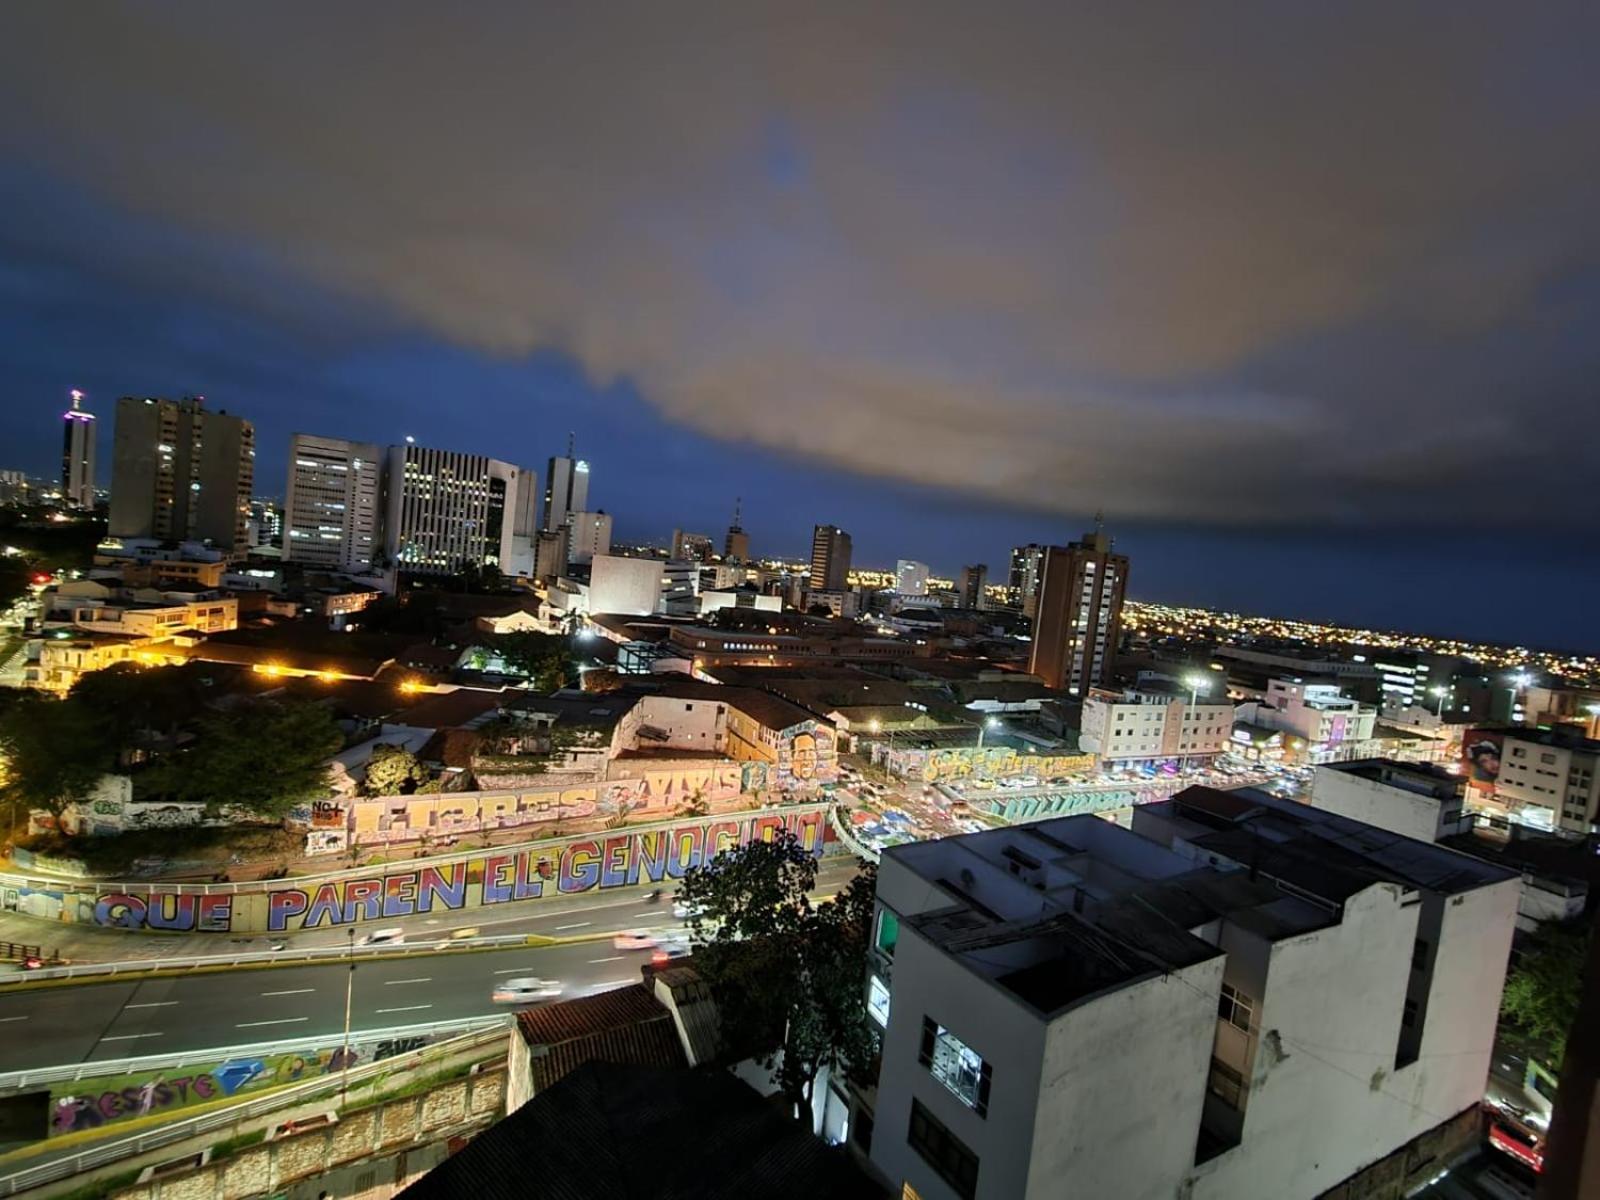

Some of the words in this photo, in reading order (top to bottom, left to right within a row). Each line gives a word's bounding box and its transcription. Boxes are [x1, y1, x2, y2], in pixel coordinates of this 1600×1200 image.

[95, 892, 231, 933] QUE
[267, 862, 467, 932] PAREN
[481, 851, 543, 906] EL
